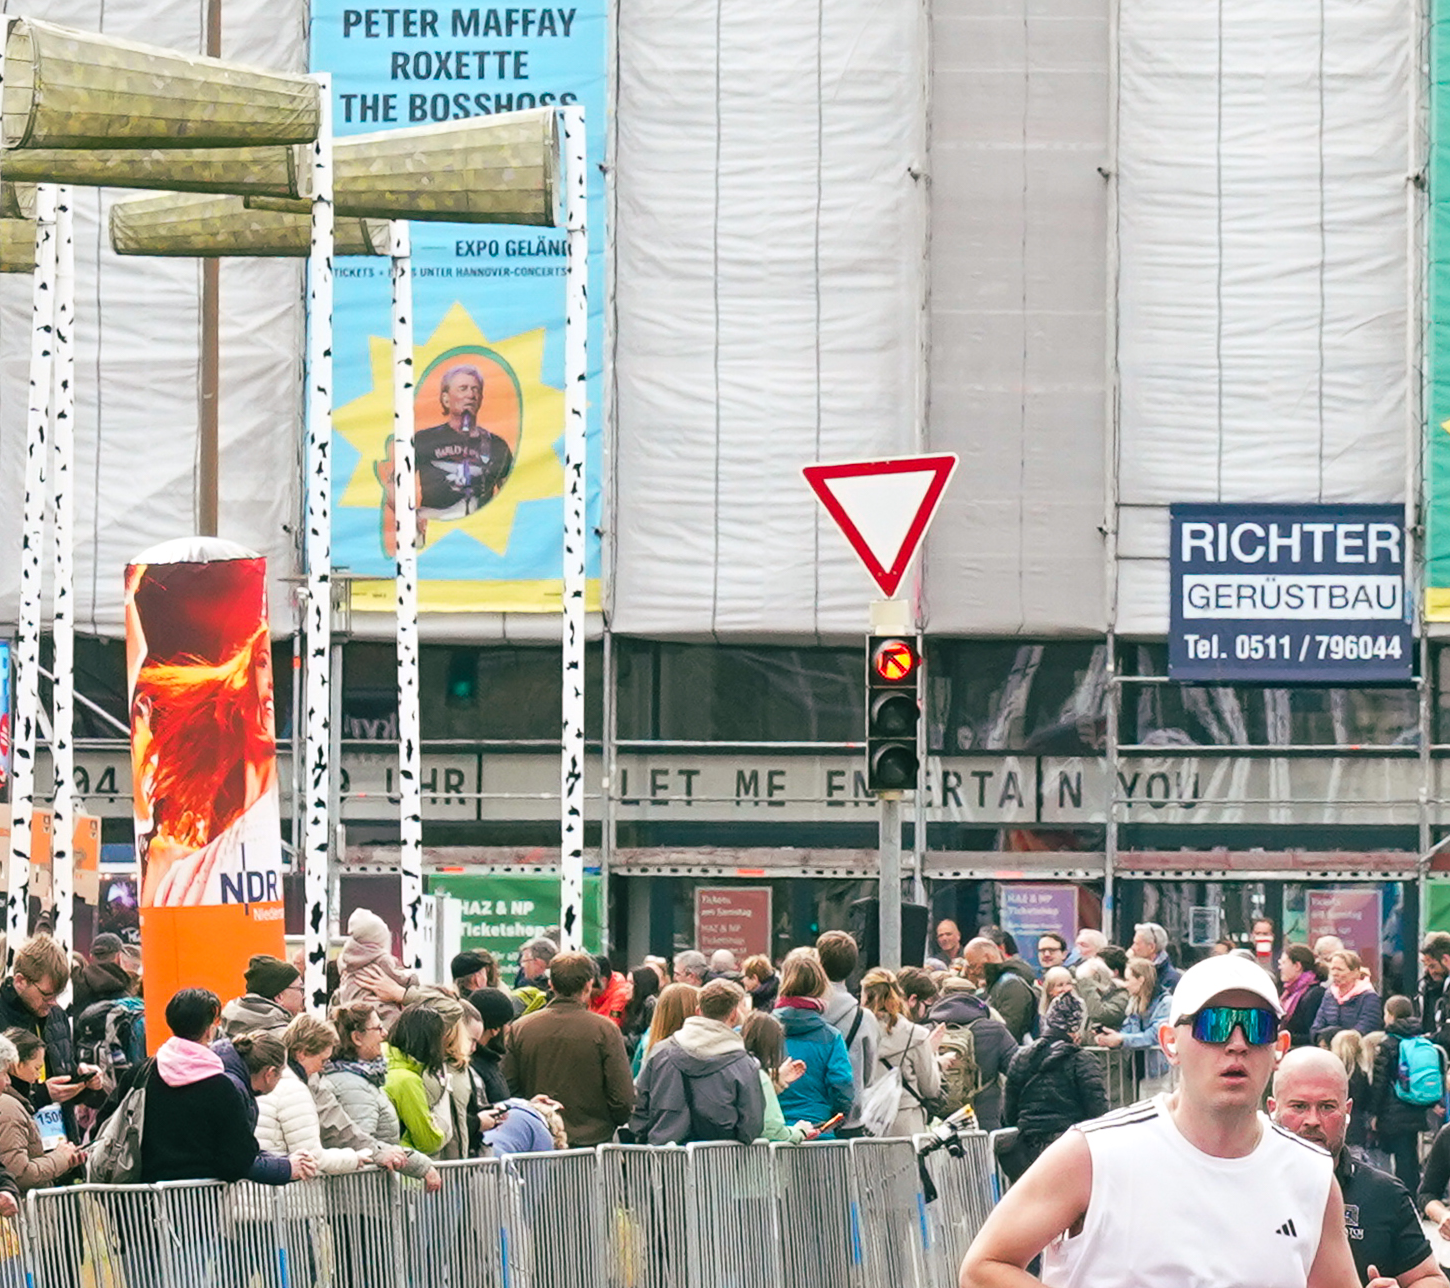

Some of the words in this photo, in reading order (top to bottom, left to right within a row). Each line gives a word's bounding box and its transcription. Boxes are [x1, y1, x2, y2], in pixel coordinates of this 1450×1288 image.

[343, 9, 439, 38] PETER
[451, 9, 577, 38] MAFFAY
[391, 50, 529, 80] ROXETTE
[340, 93, 398, 123] THE
[456, 240, 500, 258] EXPO
[1181, 522, 1401, 563] RICHTER
[1188, 577, 1396, 610] GERÜSTBAU
[1184, 634, 1227, 659] Tel.
[1235, 634, 1290, 659] 0511
[1299, 634, 1311, 662] /
[1315, 634, 1402, 660] 796044
[622, 768, 701, 806] LET
[735, 769, 787, 805] ME
[220, 870, 279, 905] NDR
[461, 900, 493, 915] HAZ
[495, 900, 507, 915] &
[510, 900, 535, 915] NP
[461, 922, 546, 938] Ticketshop
